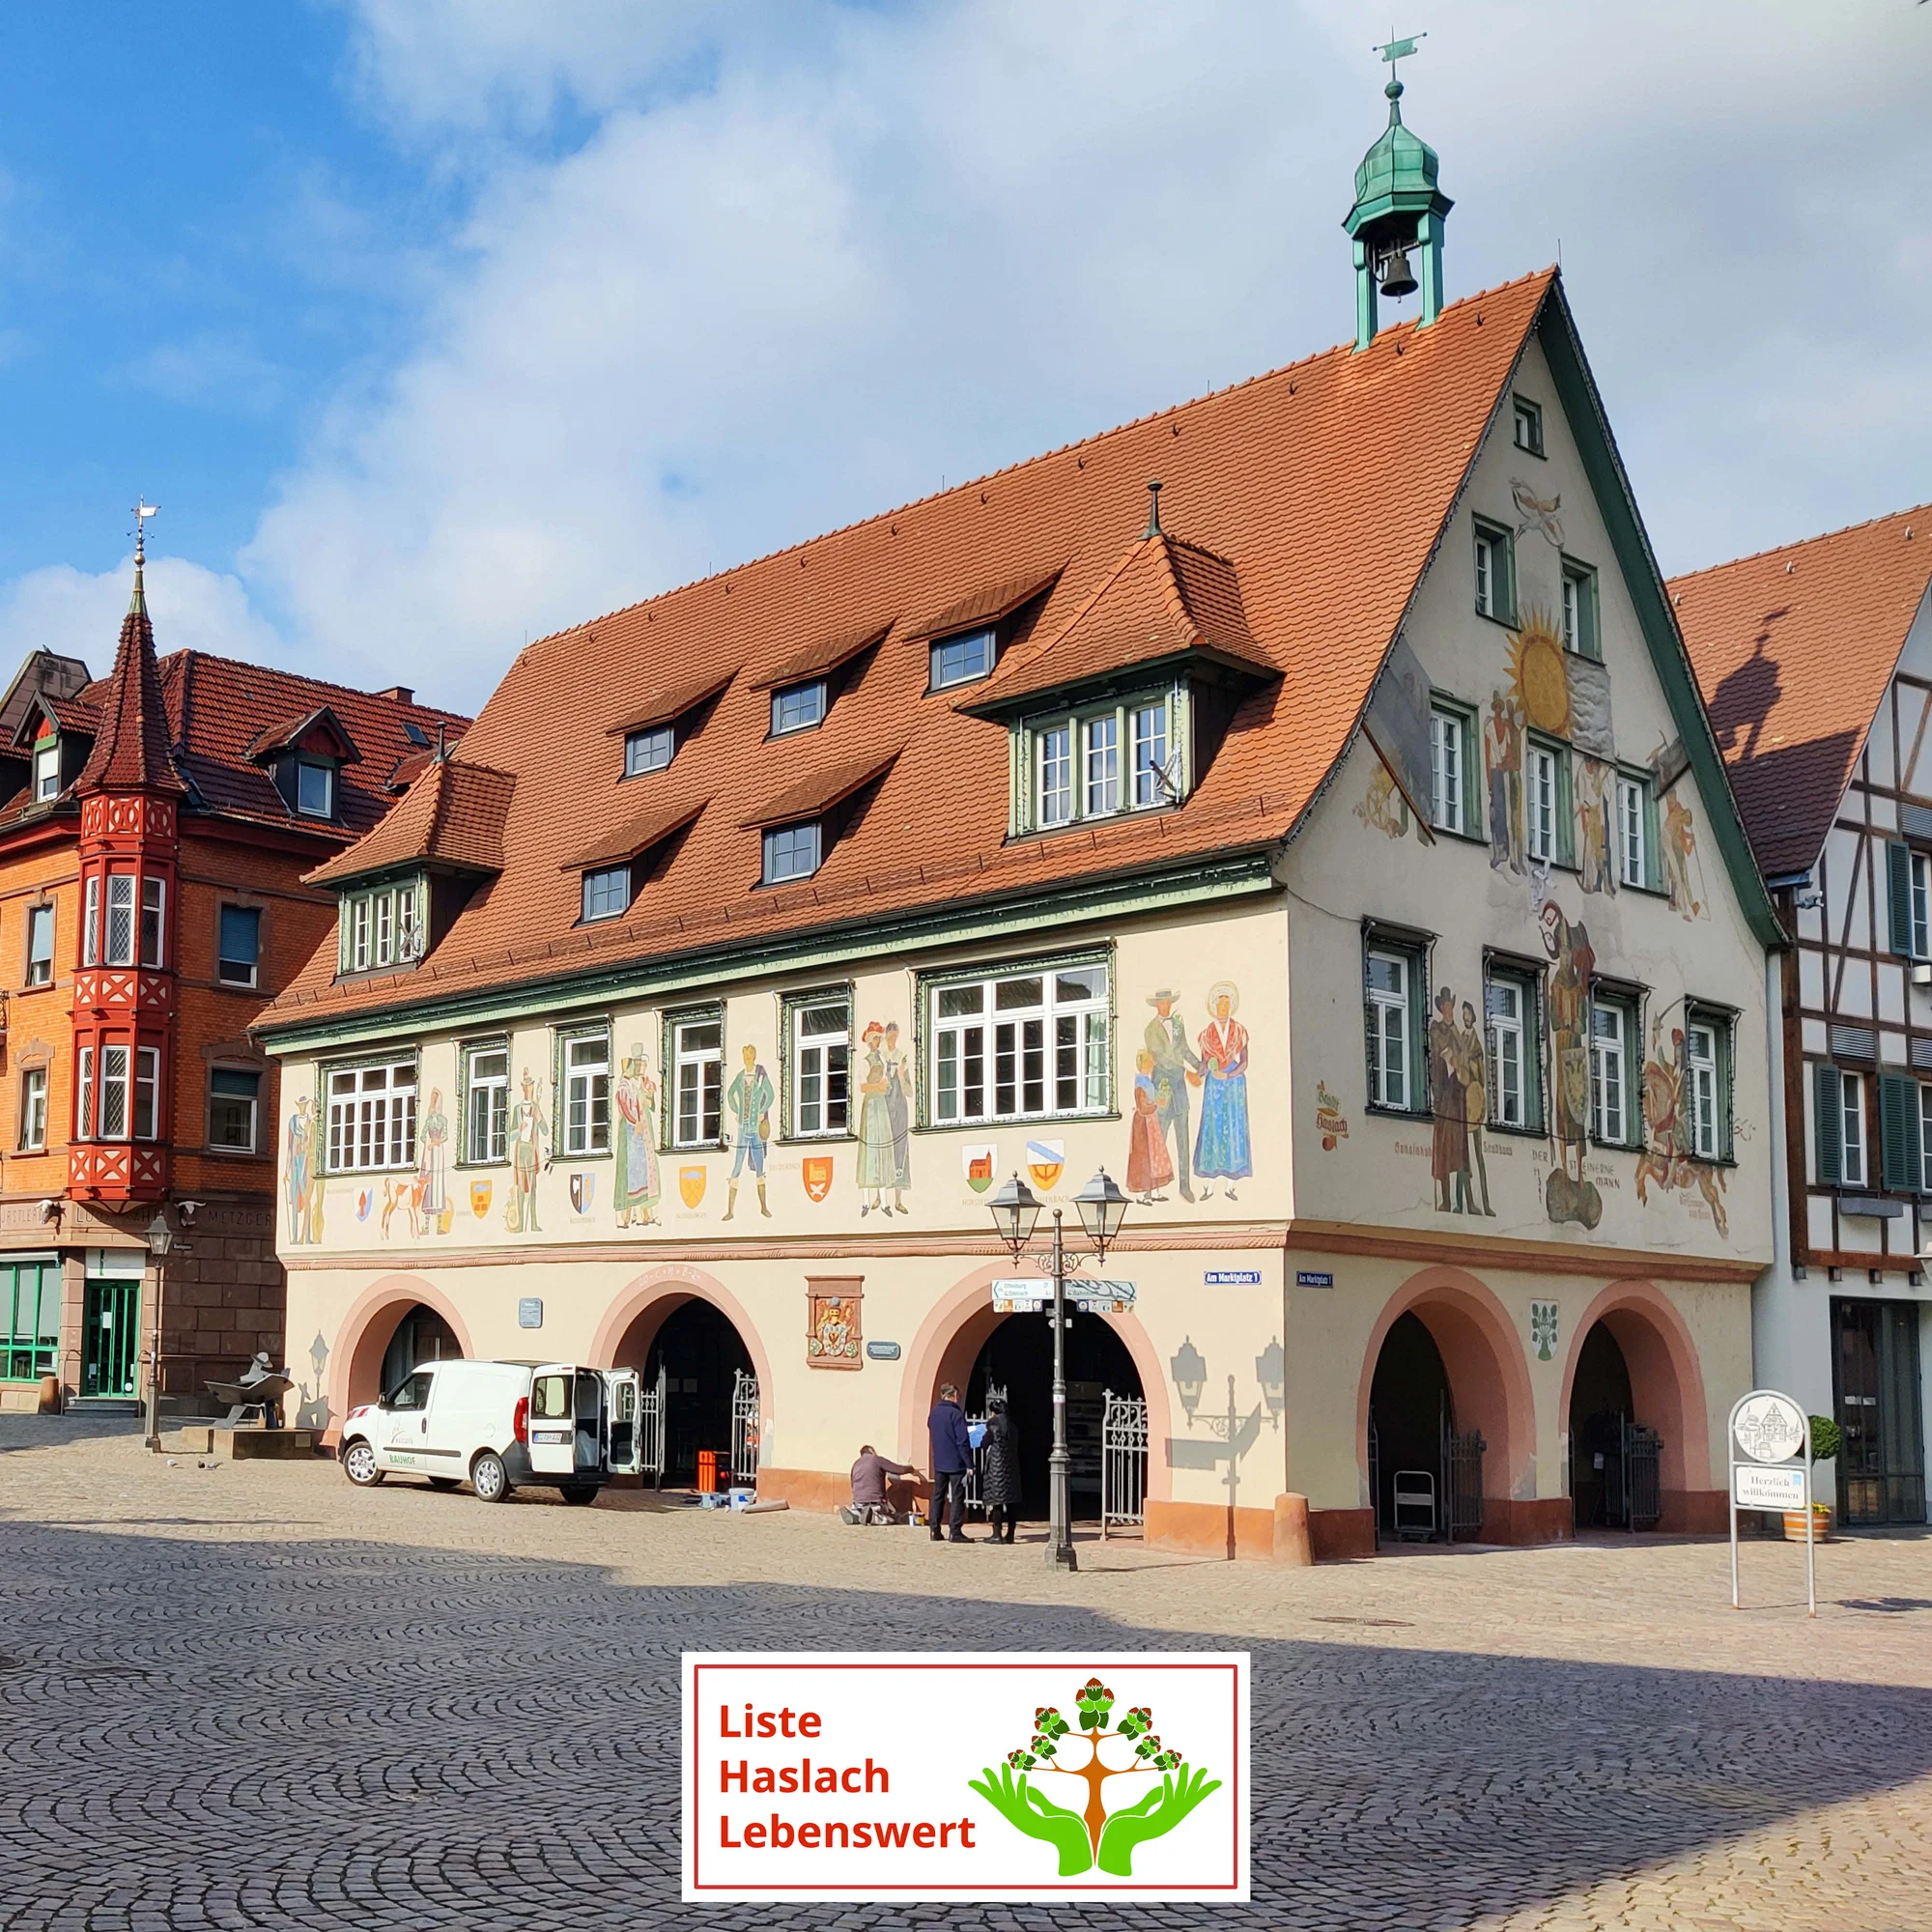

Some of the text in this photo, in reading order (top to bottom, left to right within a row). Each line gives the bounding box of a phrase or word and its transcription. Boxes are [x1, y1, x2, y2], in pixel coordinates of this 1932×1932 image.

[1316, 1112, 1348, 1133] Haslach
[1531, 1149, 1548, 1163] DER
[1595, 1176, 1621, 1189] MANN
[1207, 1272, 1217, 1283] Am
[1218, 1272, 1254, 1285] Marktplatz
[1298, 1273, 1306, 1283] Am
[1306, 1274, 1328, 1286] Marktplatz
[389, 1454, 416, 1465] BAUHOF
[1751, 1476, 1790, 1487] Herzlich
[1743, 1487, 1799, 1499] willkommen
